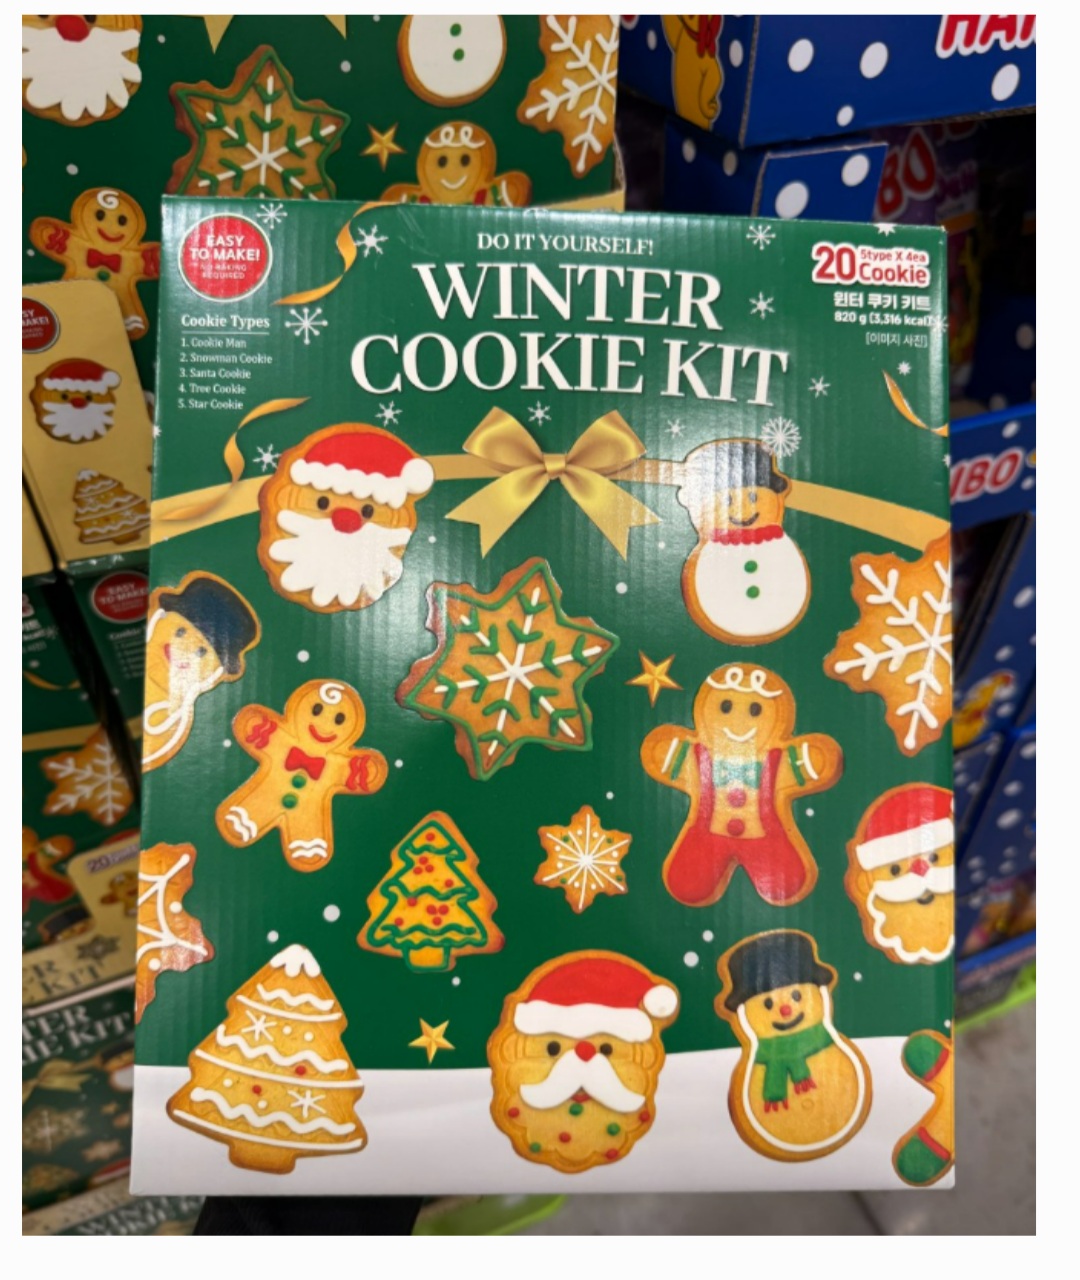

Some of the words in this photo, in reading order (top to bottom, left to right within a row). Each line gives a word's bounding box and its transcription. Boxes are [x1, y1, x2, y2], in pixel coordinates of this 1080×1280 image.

[205, 234, 246, 248] EASY
[476, 232, 509, 251] DO
[513, 232, 535, 251] IT
[538, 233, 655, 257] YOURSELF!
[189, 247, 210, 261] TO
[213, 247, 261, 262] MAKE!
[813, 244, 856, 282] 20
[859, 248, 893, 263] 5type
[905, 251, 927, 263] 4ea
[859, 262, 928, 285] Cookie
[411, 262, 724, 332] WINTER
[833, 291, 864, 308] 윈터
[867, 293, 898, 310] 쿠키
[901, 294, 931, 312] 키트
[180, 314, 227, 328] Cookie
[230, 314, 270, 331] Types
[833, 311, 856, 323] 820
[858, 314, 867, 326] g
[868, 312, 902, 325] (3,316
[180, 337, 189, 348] 1.
[191, 337, 224, 349] Cookie
[225, 337, 247, 349] Man
[865, 331, 901, 347] [이미지
[903, 334, 928, 349] 사진]
[179, 352, 189, 363] 2.
[190, 352, 238, 364] Snowman
[239, 353, 273, 365] Cookie
[178, 367, 188, 378] 3.
[189, 367, 217, 379] Santa
[218, 368, 252, 380] Cookie
[350, 331, 645, 395] COOKIE
[659, 337, 790, 408] KIT
[177, 383, 188, 394] 4.
[189, 383, 212, 395] Tree
[212, 383, 247, 395] Cookie
[177, 398, 187, 409] 5.
[188, 398, 209, 410] Star
[210, 399, 244, 410] Cookie
